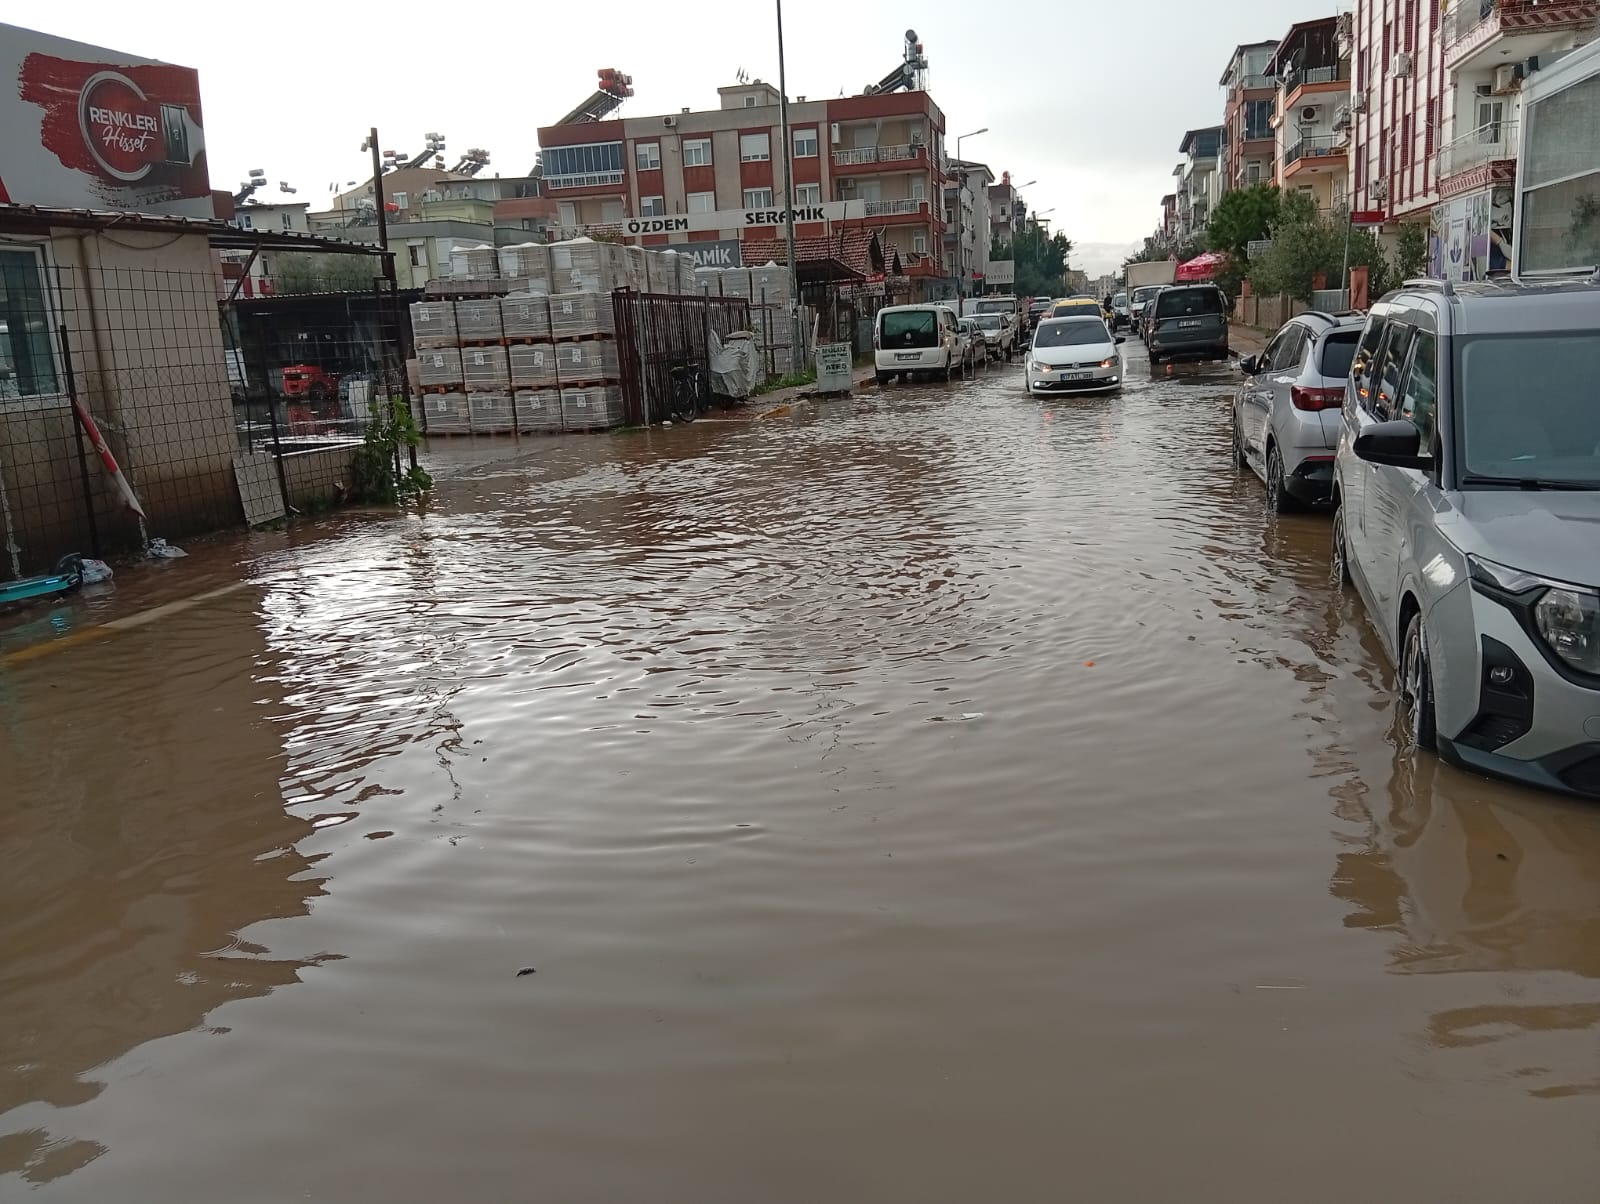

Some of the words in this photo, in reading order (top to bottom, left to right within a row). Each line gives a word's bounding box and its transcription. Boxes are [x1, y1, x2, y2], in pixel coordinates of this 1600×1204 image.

[102, 126, 155, 152] Hisset
[628, 218, 688, 234] ÖZDEM
[745, 205, 825, 225] SERAMİK
